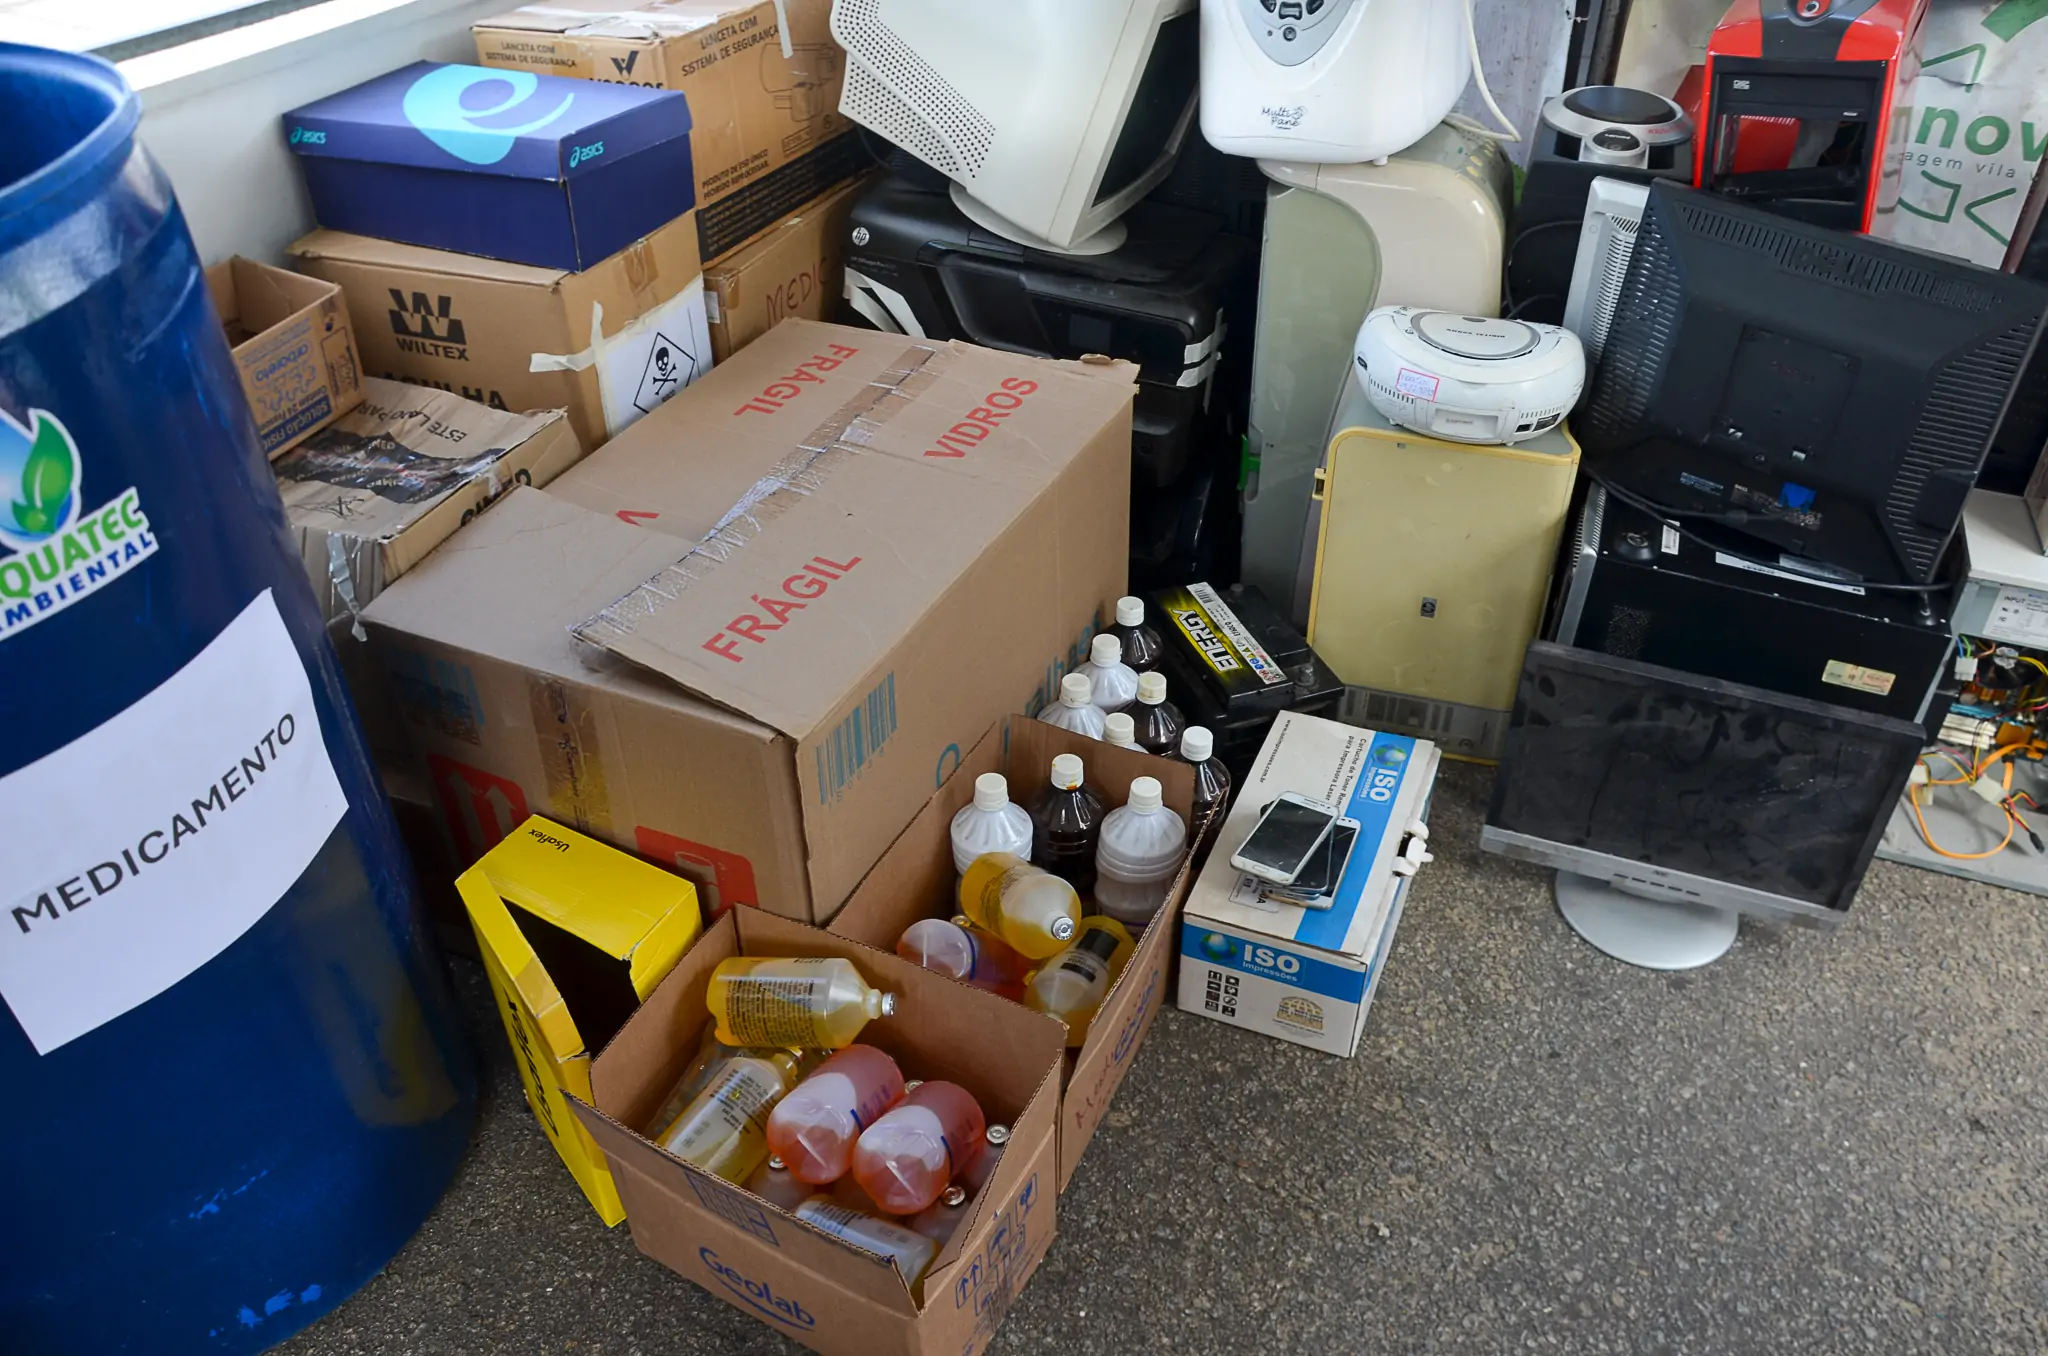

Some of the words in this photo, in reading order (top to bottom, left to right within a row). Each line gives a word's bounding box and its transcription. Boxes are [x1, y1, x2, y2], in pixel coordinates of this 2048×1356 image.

[701, 26, 737, 49] LANCETA
[738, 16, 758, 32] COM
[485, 52, 516, 63] SISTEMA
[518, 54, 528, 63] DE
[529, 55, 577, 68] SEGURANÇA
[501, 42, 534, 52] LANCETA
[537, 44, 555, 53] COM
[682, 52, 719, 76] SISTEMA
[720, 46, 731, 59] DE
[732, 25, 779, 54] SEGURANÇA
[302, 130, 326, 145] asics
[580, 141, 604, 161] asics
[1976, 163, 2016, 178] vila
[853, 227, 869, 246] hp
[395, 336, 470, 361] WILTEX
[734, 343, 859, 418] FRÁGIL
[286, 401, 329, 436] SOLUÇÃO
[924, 376, 1039, 459] VIDROS
[427, 422, 468, 443] ESTE
[0, 494, 143, 604] QUATEC
[0, 532, 152, 633] MBIENTAL
[702, 555, 862, 663] FRÁGIL
[1172, 608, 1241, 672] ENERGY
[1345, 735, 1354, 750] para
[1352, 738, 1367, 765] Cartucho
[1341, 774, 1354, 792] Toner
[1348, 766, 1356, 774] de
[1325, 783, 1337, 801] Laser
[1369, 768, 1398, 802] ISO
[12, 713, 296, 934] MEDICAMENTO
[528, 828, 570, 853] Usaflex
[1242, 961, 1298, 982] Impressões
[1244, 944, 1300, 974] ISO
[699, 1246, 815, 1327] Geolab
